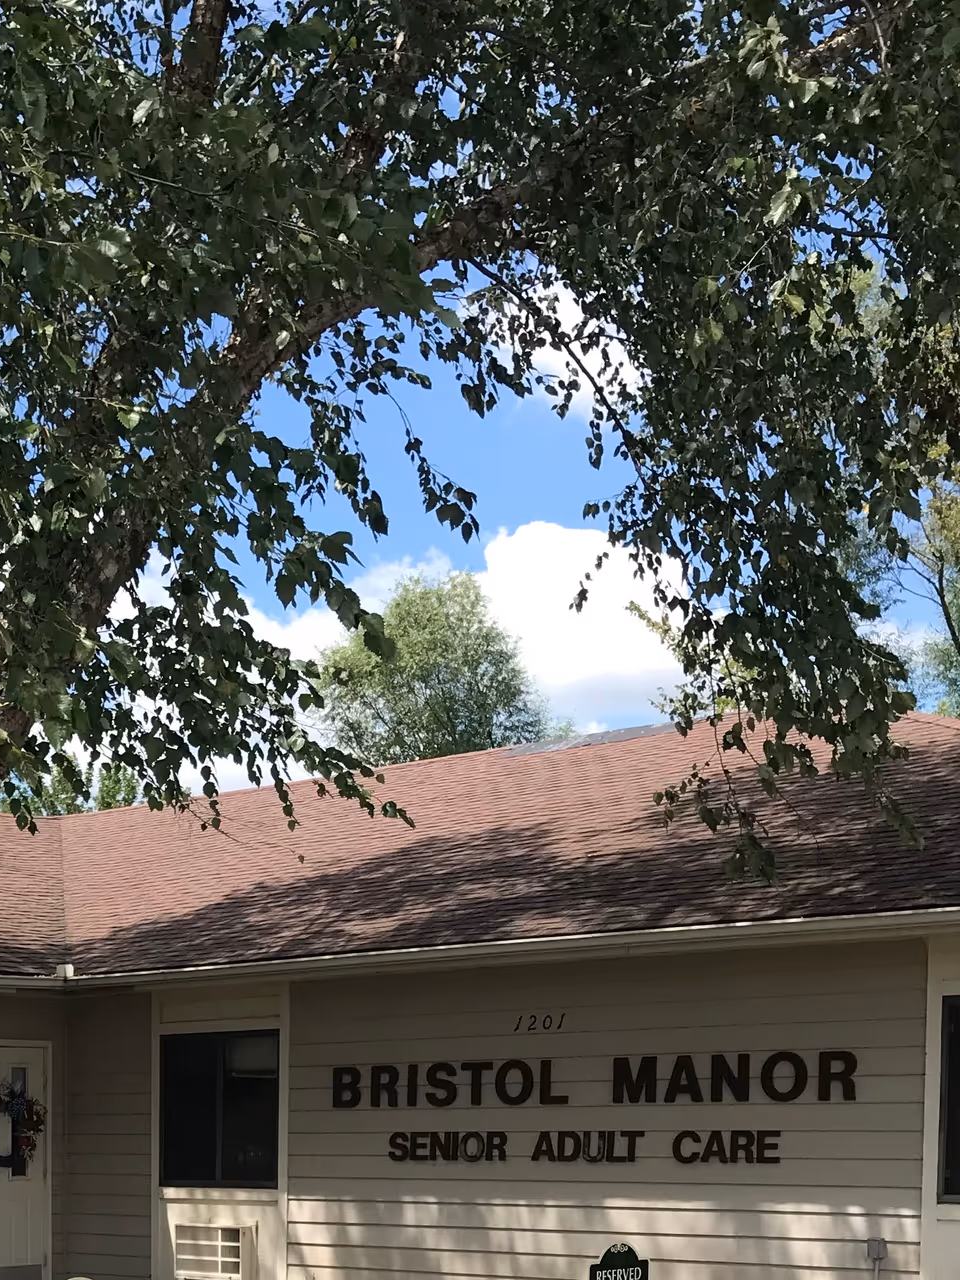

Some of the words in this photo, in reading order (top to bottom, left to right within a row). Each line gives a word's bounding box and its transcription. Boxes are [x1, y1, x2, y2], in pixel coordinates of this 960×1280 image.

[513, 1012, 567, 1032] 1201
[332, 1059, 569, 1108] BRISTOL
[612, 1050, 858, 1103] MANOR
[388, 1131, 508, 1162] SENIOR
[531, 1130, 645, 1163] ADULT
[672, 1130, 781, 1164] CARE
